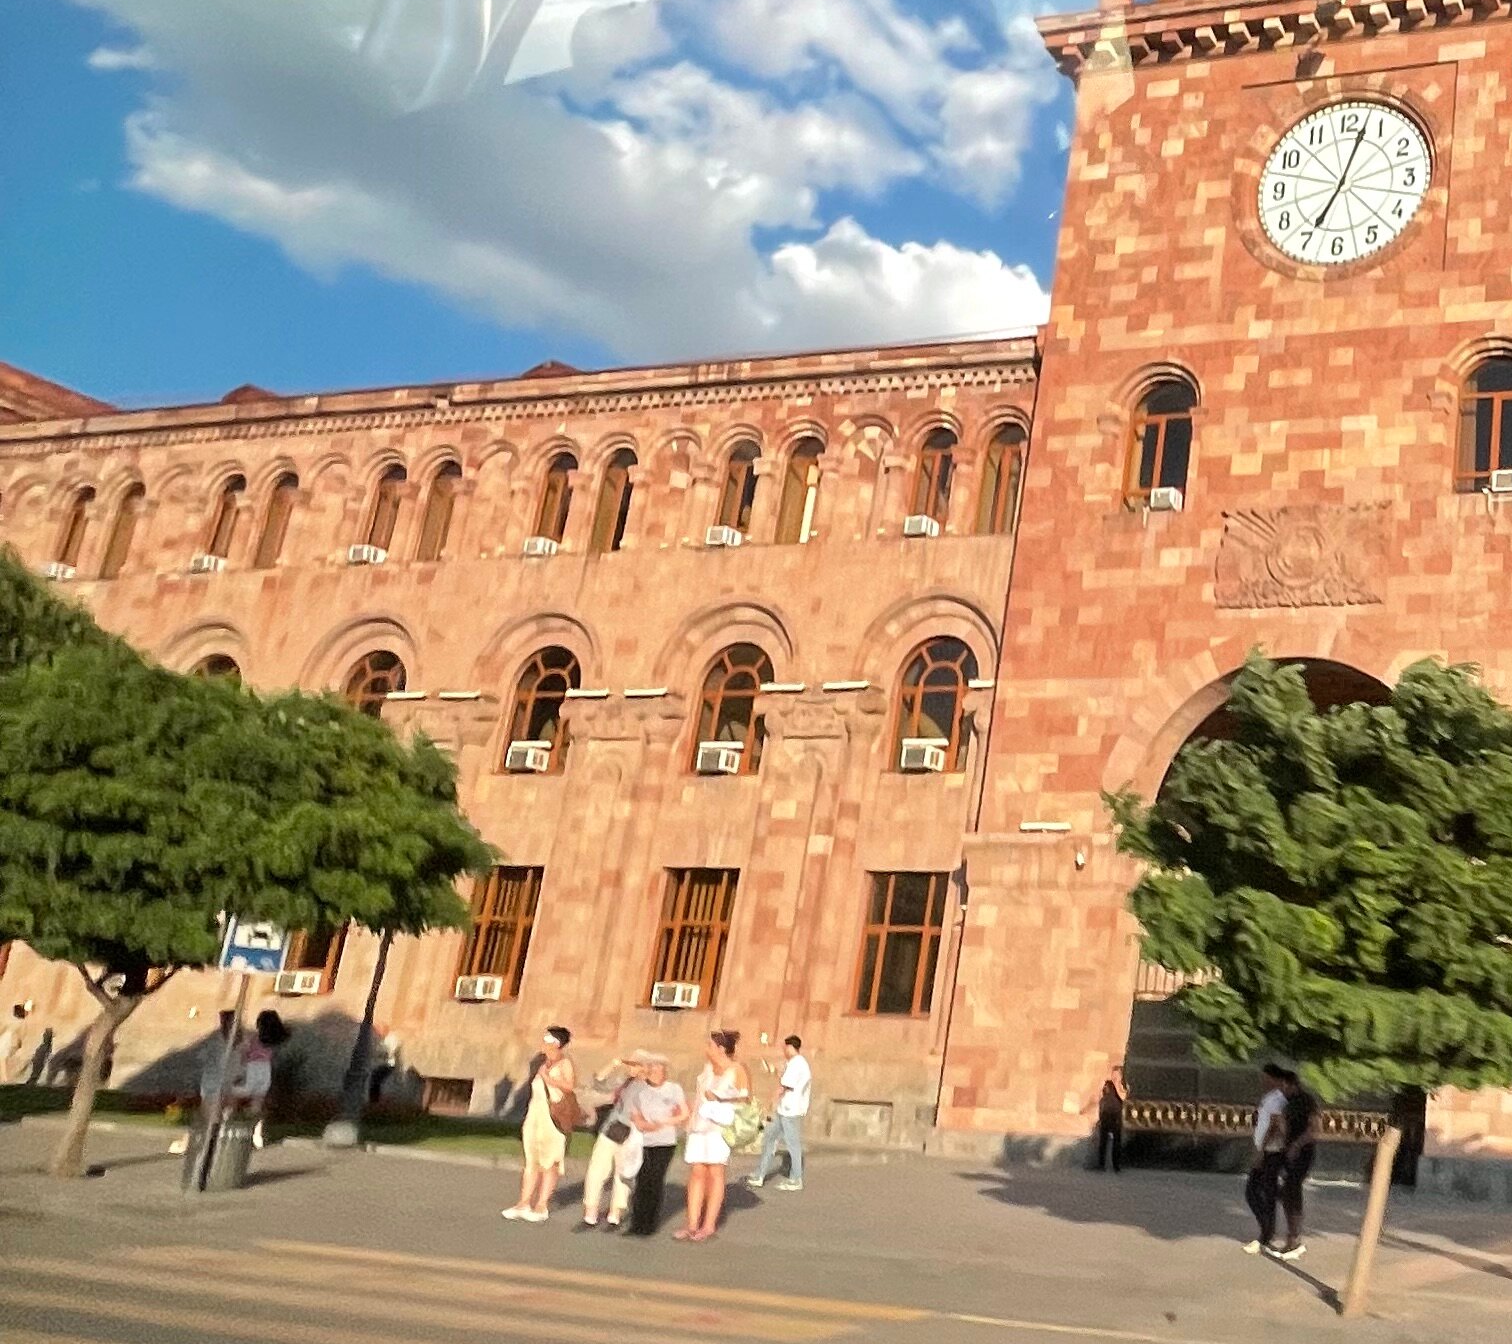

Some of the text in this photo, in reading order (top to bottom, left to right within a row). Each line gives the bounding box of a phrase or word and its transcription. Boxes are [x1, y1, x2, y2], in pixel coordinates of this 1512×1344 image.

[1340, 114, 1359, 133] 12
[1378, 118, 1383, 138] 1
[1309, 125, 1324, 145] 11
[1396, 137, 1410, 157] 2
[1282, 149, 1300, 170] 10
[1403, 167, 1415, 186] 3
[1273, 181, 1285, 201] 9
[1391, 199, 1403, 218] 4
[1279, 211, 1290, 231] 8
[1300, 231, 1313, 251] 7
[1365, 225, 1379, 245] 5
[1331, 237, 1344, 256] 6
